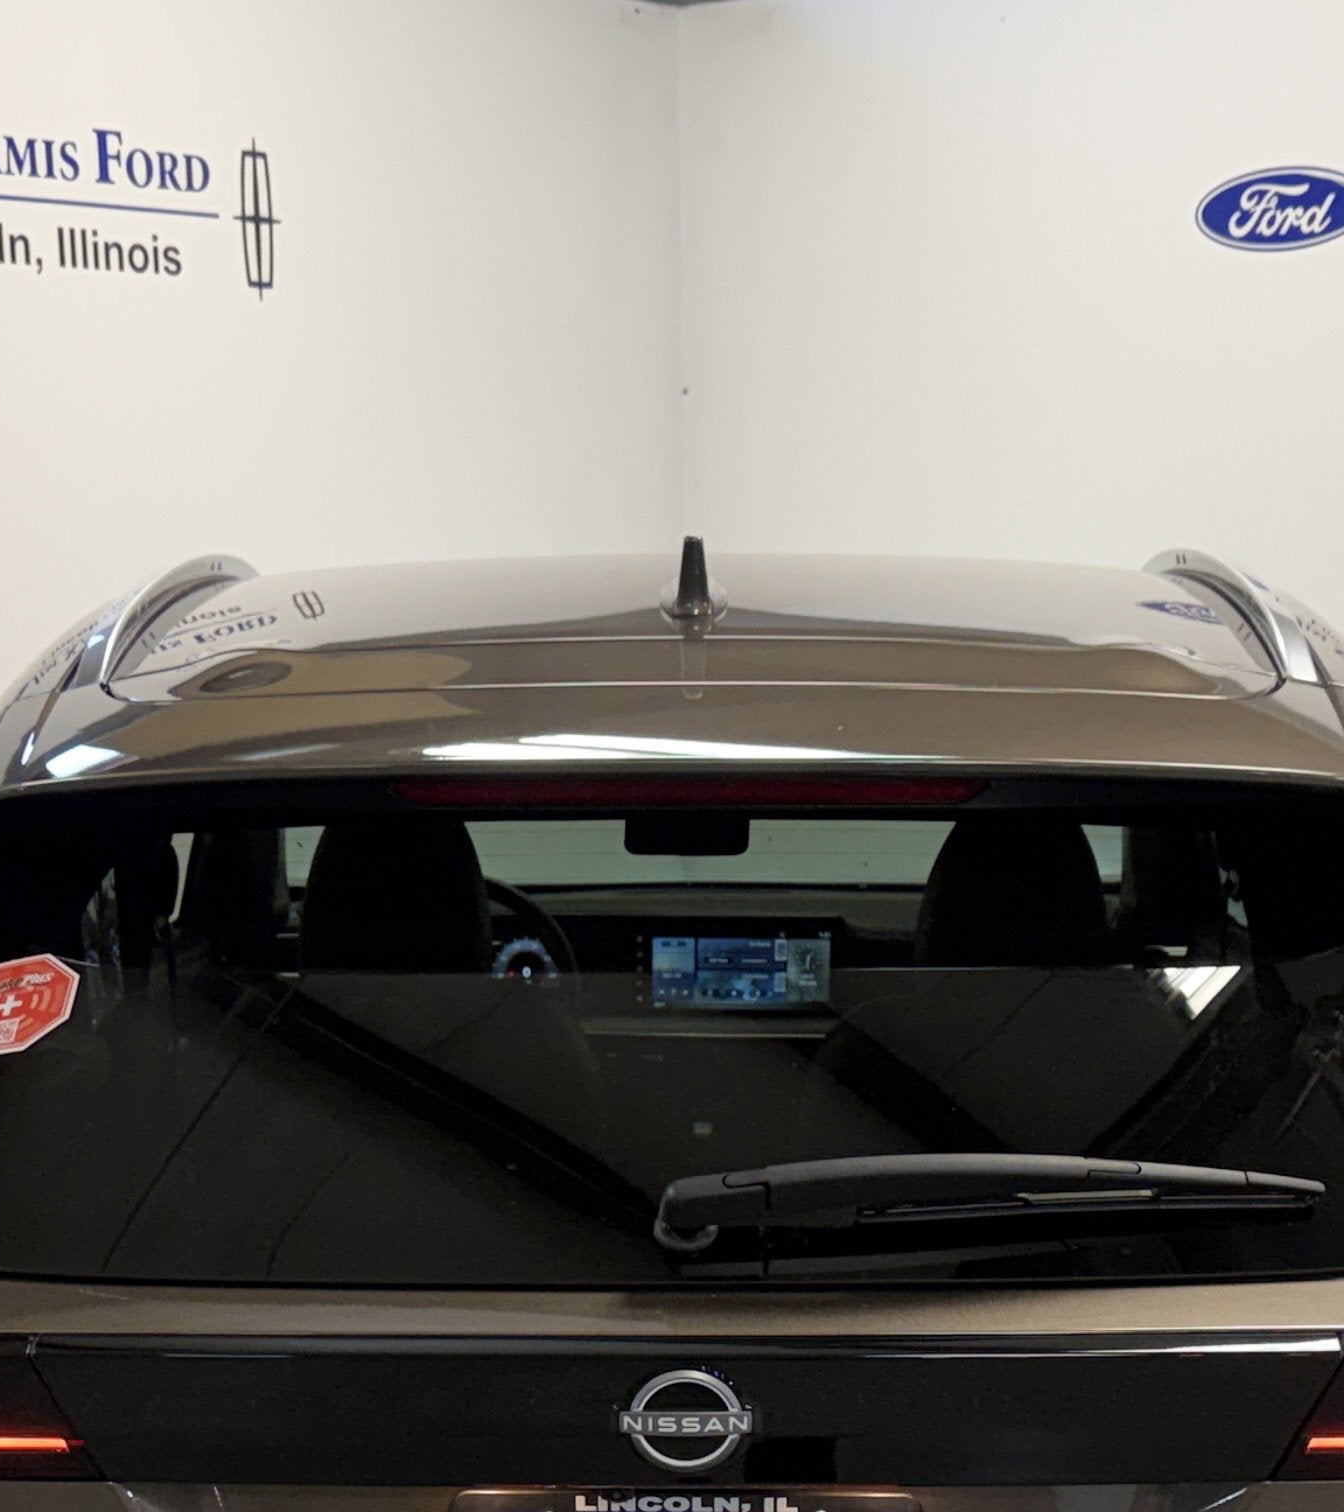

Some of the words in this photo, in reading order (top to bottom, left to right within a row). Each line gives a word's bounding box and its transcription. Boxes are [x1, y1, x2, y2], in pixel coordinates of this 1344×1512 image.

[92, 128, 211, 193] FORD
[1227, 182, 1335, 239] Ford
[56, 226, 184, 277] Illinois
[622, 1414, 749, 1434] NISSAN
